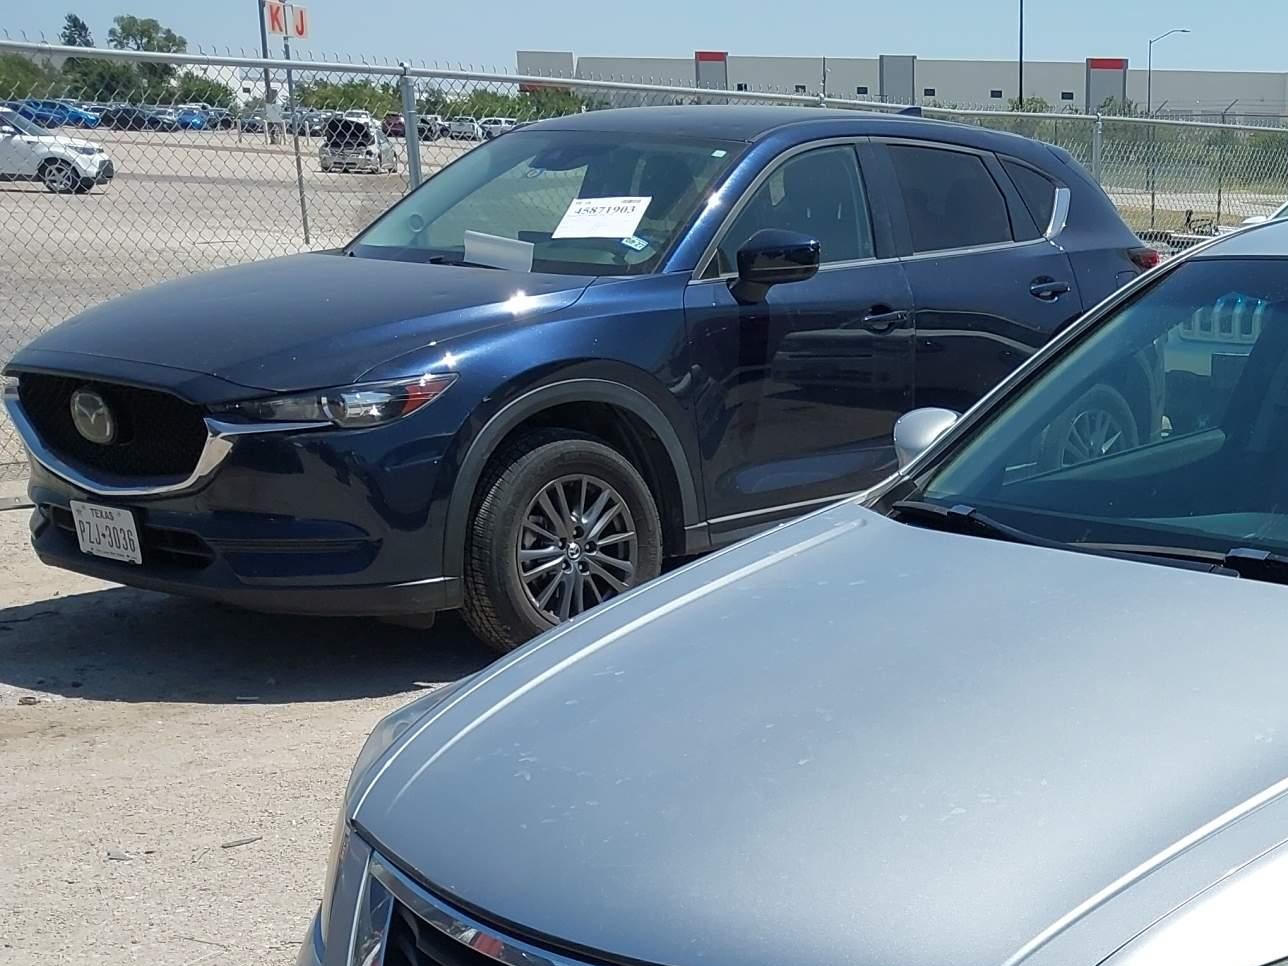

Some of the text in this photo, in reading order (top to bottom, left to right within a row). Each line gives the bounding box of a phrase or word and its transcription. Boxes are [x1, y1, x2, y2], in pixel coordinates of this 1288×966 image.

[269, 5, 283, 32] K
[296, 10, 304, 35] J
[574, 205, 636, 215] 45871903
[90, 508, 114, 521] TEXAS
